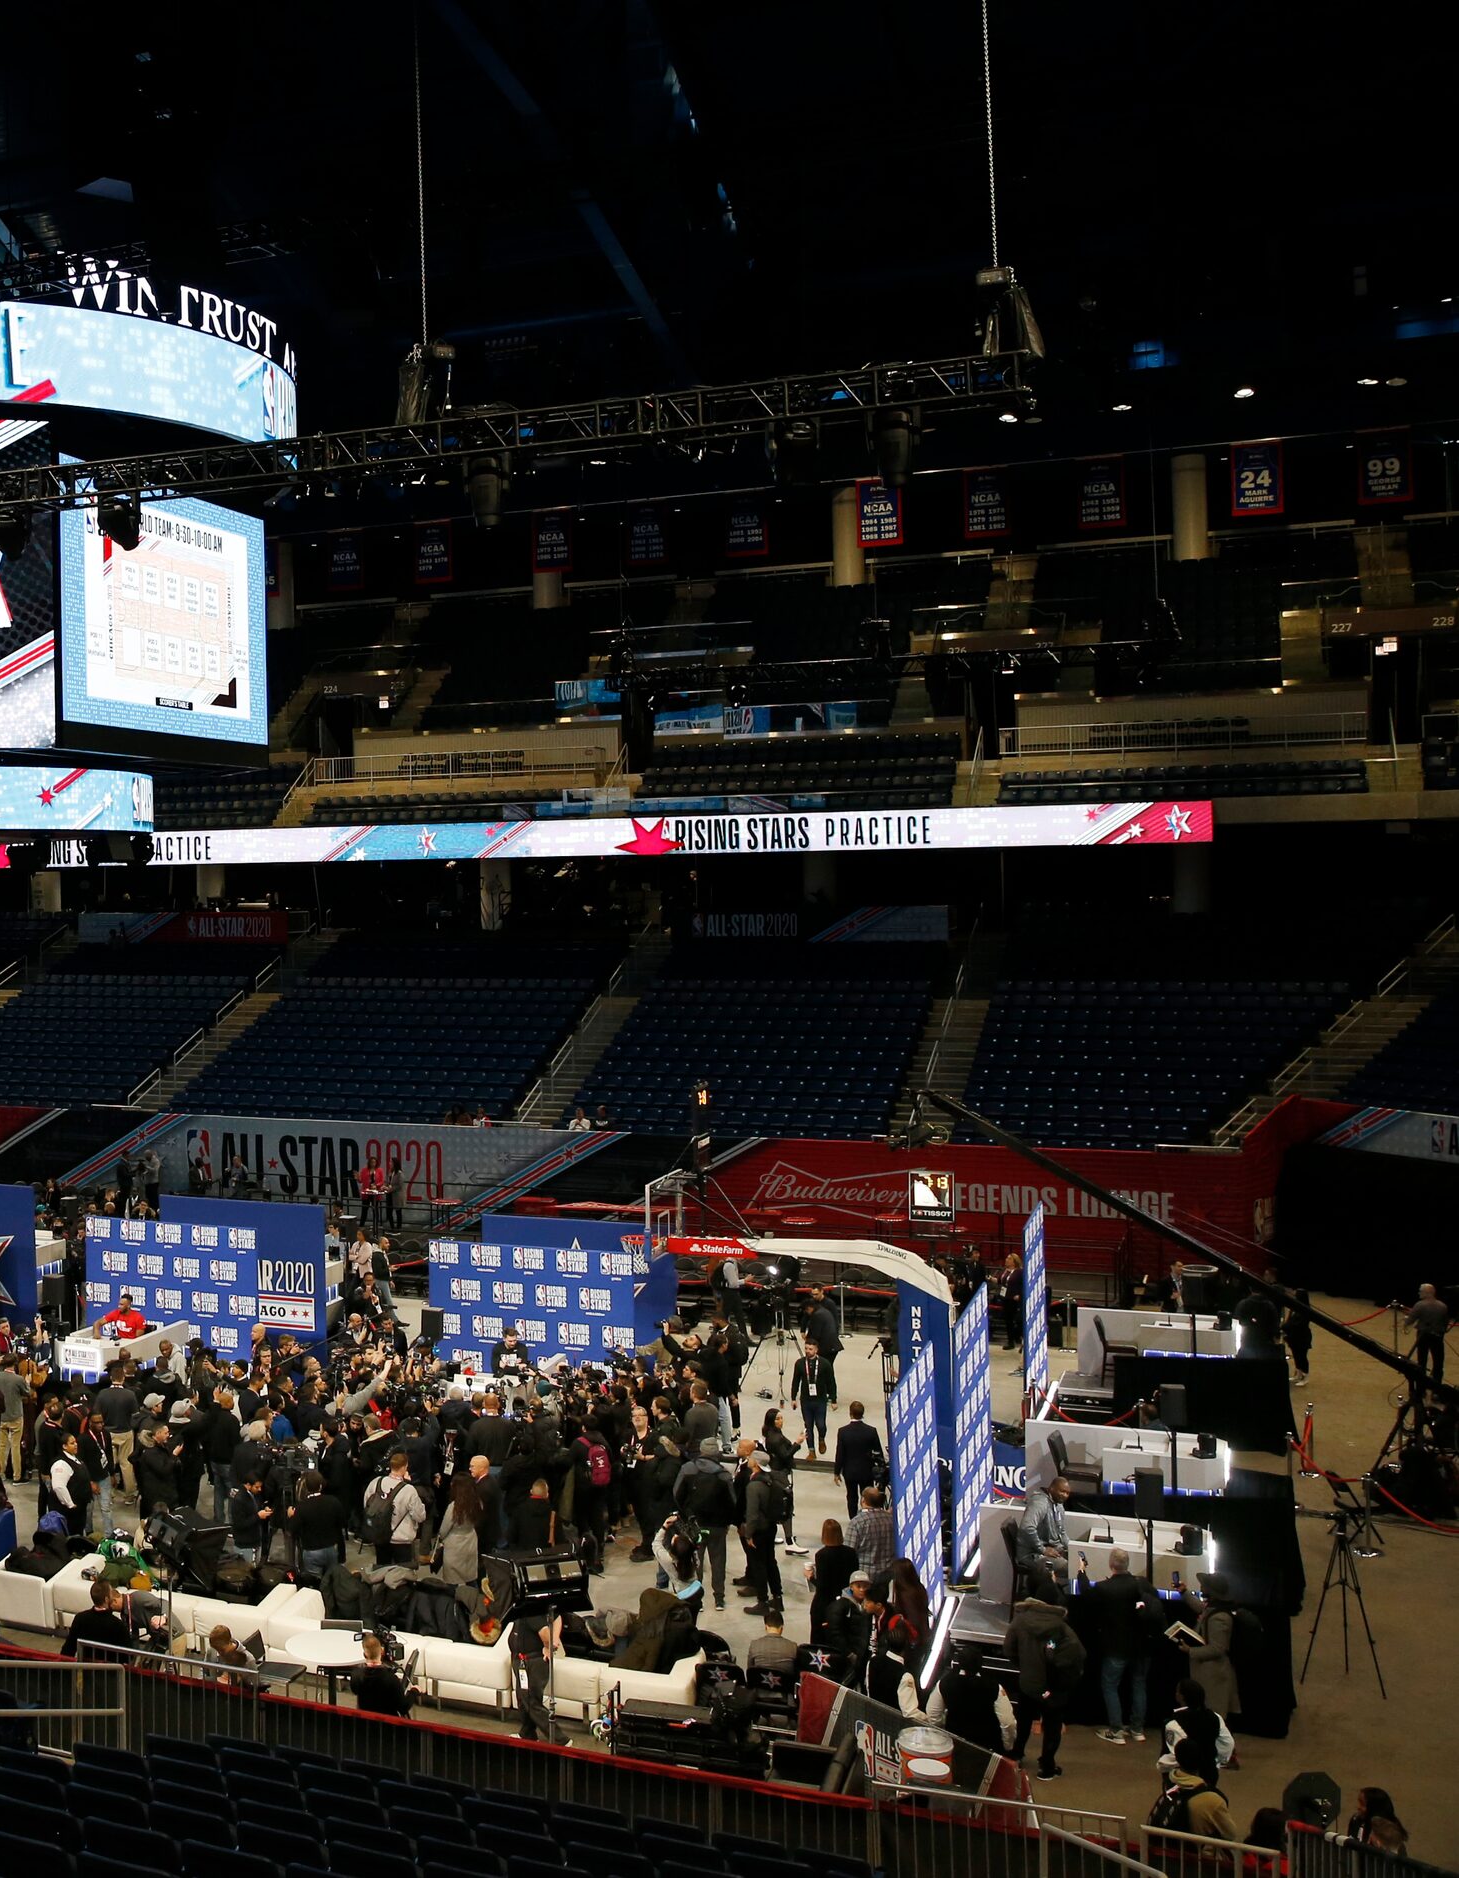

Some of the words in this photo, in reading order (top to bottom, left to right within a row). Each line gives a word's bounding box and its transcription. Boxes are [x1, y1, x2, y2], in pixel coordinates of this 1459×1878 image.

[1367, 457, 1401, 478] 99
[1240, 469, 1272, 489] 24
[1084, 482, 1116, 494] NCAA
[1244, 488, 1268, 496] MARK
[971, 493, 1002, 504] NCAA
[863, 502, 894, 513] NCAA
[731, 514, 759, 524] NCAA
[154, 516, 174, 539] TEAM:
[213, 535, 223, 554] AM
[633, 525, 660, 534] NCAA
[539, 533, 565, 542] NCAA
[420, 545, 445, 554] NCAA
[333, 553, 357, 562] NCAA
[1330, 622, 1352, 633] 227
[1431, 616, 1455, 628] 228
[323, 684, 338, 694] 224
[675, 818, 740, 851] RISING
[747, 816, 810, 849] STARS
[825, 815, 931, 847] PRACTICE
[155, 836, 212, 861] ACTICE
[759, 1173, 906, 1203] Budweiser
[954, 1183, 1057, 1216] EGENDS
[922, 1209, 952, 1218] TISSOT
[95, 1227, 111, 1238] STARS
[129, 1230, 145, 1241] STARS
[165, 1233, 181, 1244] STARS
[201, 1236, 218, 1247] STARS
[238, 1239, 255, 1249] STARS
[440, 1243, 458, 1253] RISING
[481, 1245, 501, 1256] RISING
[524, 1248, 544, 1259] RISING
[876, 1245, 908, 1260] SPALDING
[440, 1252, 458, 1264] STARS
[481, 1255, 501, 1267] STARS
[567, 1251, 588, 1261] RISING
[612, 1253, 632, 1264] RISING
[112, 1261, 128, 1272] STARS
[524, 1258, 544, 1270] STARS
[567, 1261, 588, 1273] STARS
[612, 1263, 632, 1276] STARS
[147, 1265, 163, 1275] STARS
[183, 1268, 200, 1278] STARS
[220, 1271, 237, 1281] STARS
[461, 1279, 481, 1290] RISING
[504, 1282, 523, 1293] RISING
[461, 1290, 481, 1301] STARS
[547, 1285, 567, 1296] RISING
[591, 1289, 611, 1300] RISING
[504, 1292, 523, 1304] STARS
[547, 1295, 567, 1308] STARS
[591, 1299, 611, 1311] STARS
[484, 1317, 502, 1327] RISING
[526, 1320, 546, 1331] RISING
[911, 1306, 922, 1342] NBA
[484, 1327, 502, 1338] STARS
[569, 1323, 589, 1334] RISING
[526, 1330, 546, 1342] STARS
[569, 1334, 589, 1346] STARS
